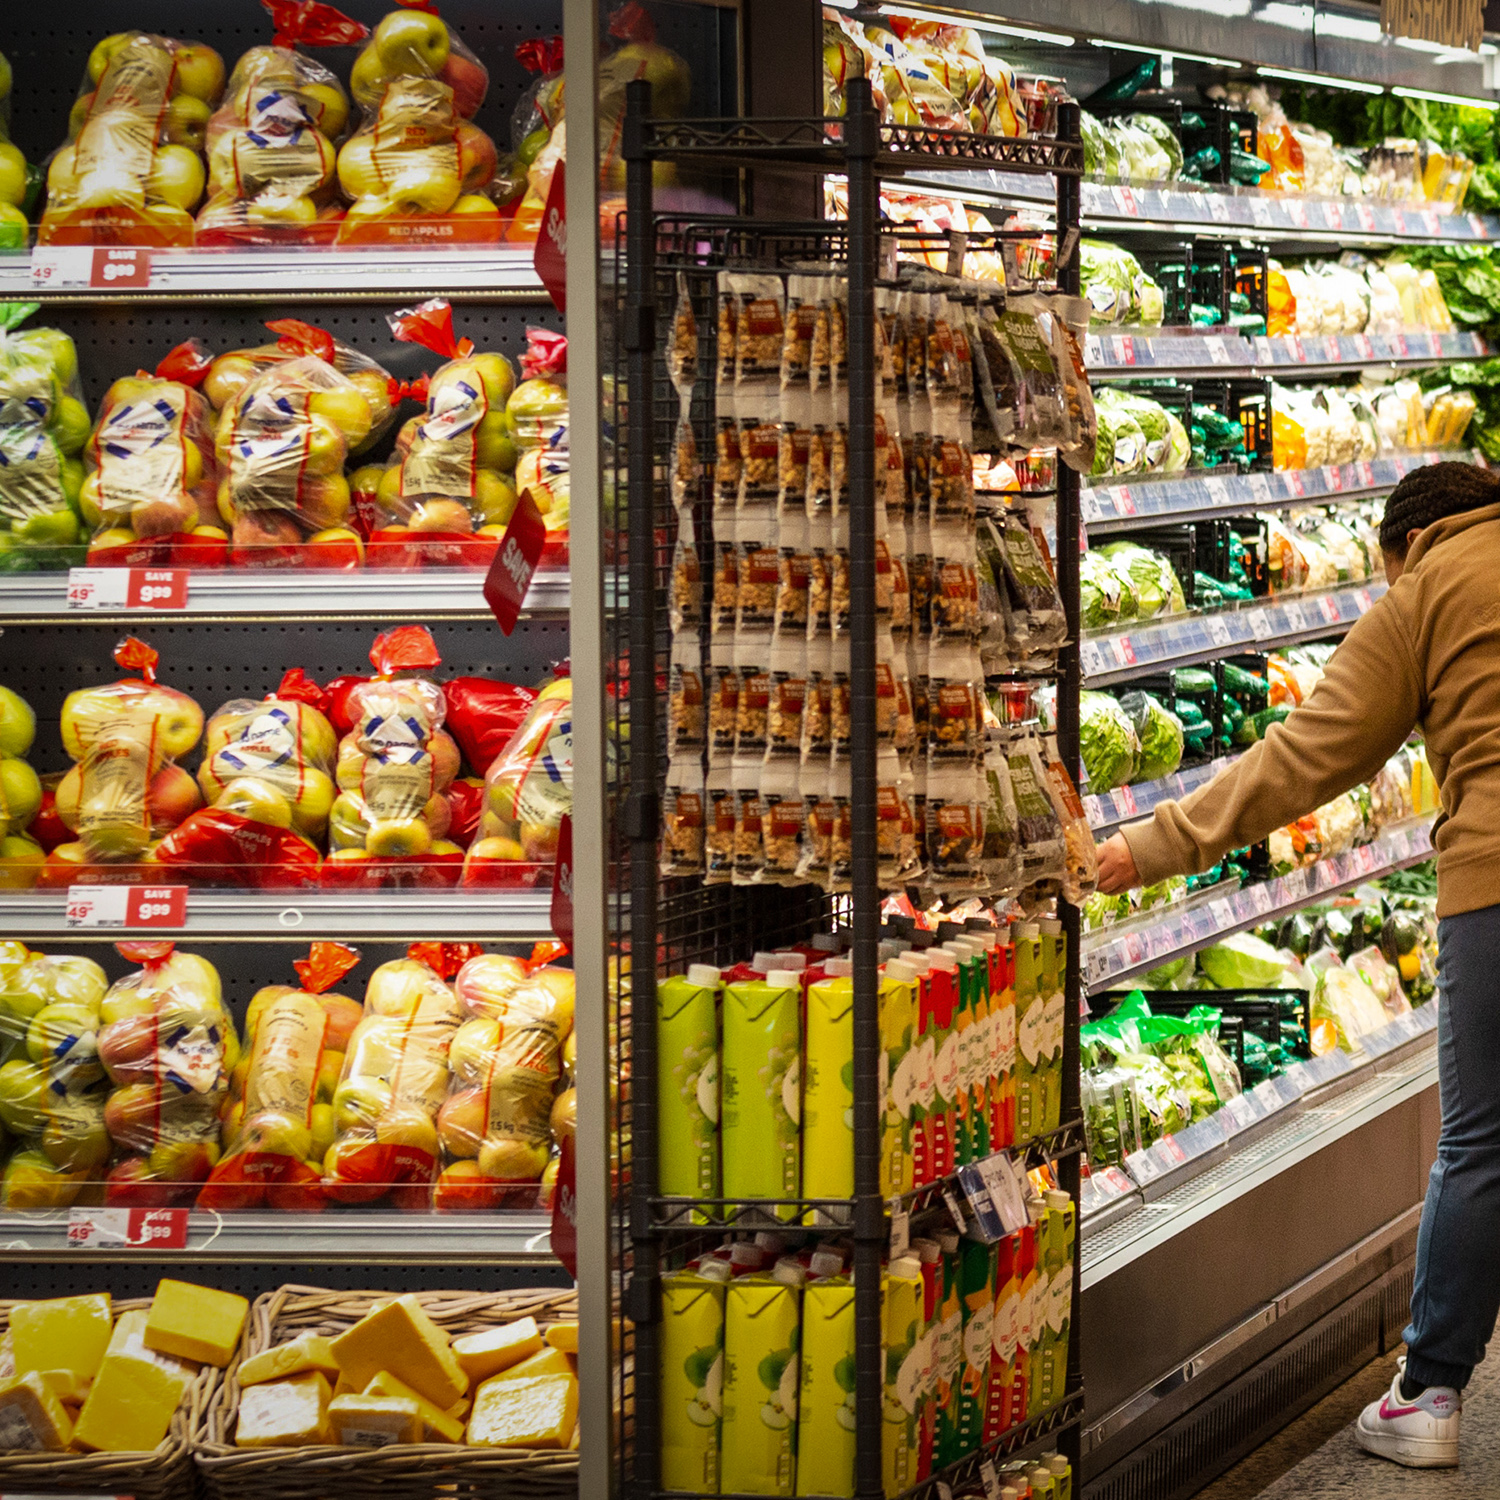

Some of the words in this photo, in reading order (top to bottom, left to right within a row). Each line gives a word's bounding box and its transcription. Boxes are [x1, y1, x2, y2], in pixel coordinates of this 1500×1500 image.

[389, 226, 410, 236] RED
[412, 226, 454, 236] APPLES
[108, 250, 137, 260] SAVE
[502, 537, 532, 594] SAVE
[145, 572, 173, 582] SAVE
[144, 890, 171, 899] SAVE
[145, 1212, 172, 1221] SAVE
